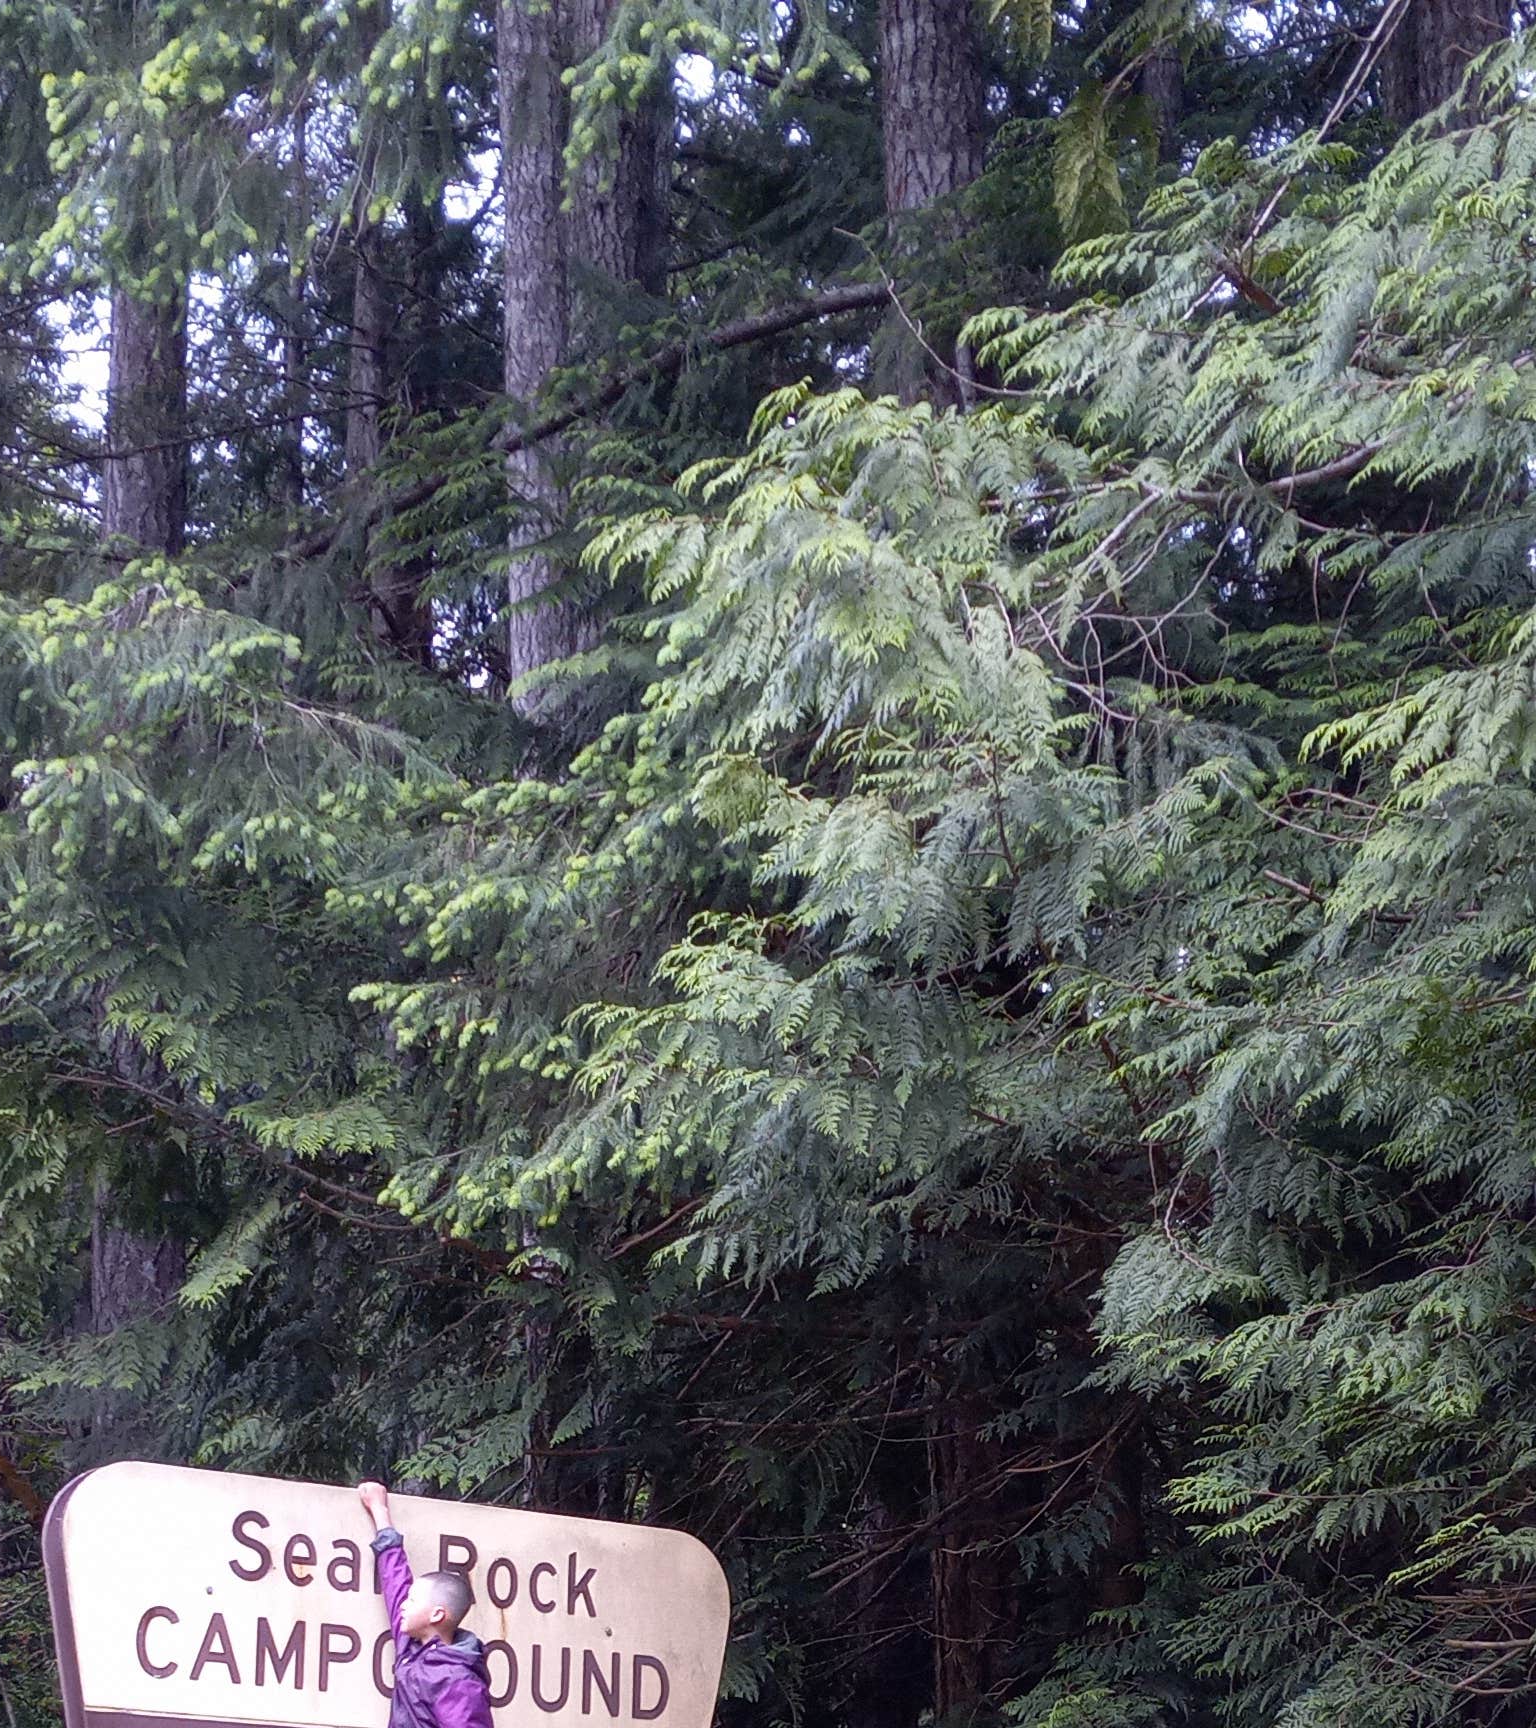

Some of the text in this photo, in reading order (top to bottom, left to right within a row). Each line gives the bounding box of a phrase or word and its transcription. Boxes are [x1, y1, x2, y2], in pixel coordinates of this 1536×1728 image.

[228, 1510, 598, 1619] Sea Rock
[135, 1604, 671, 1720] CAMPOUND
